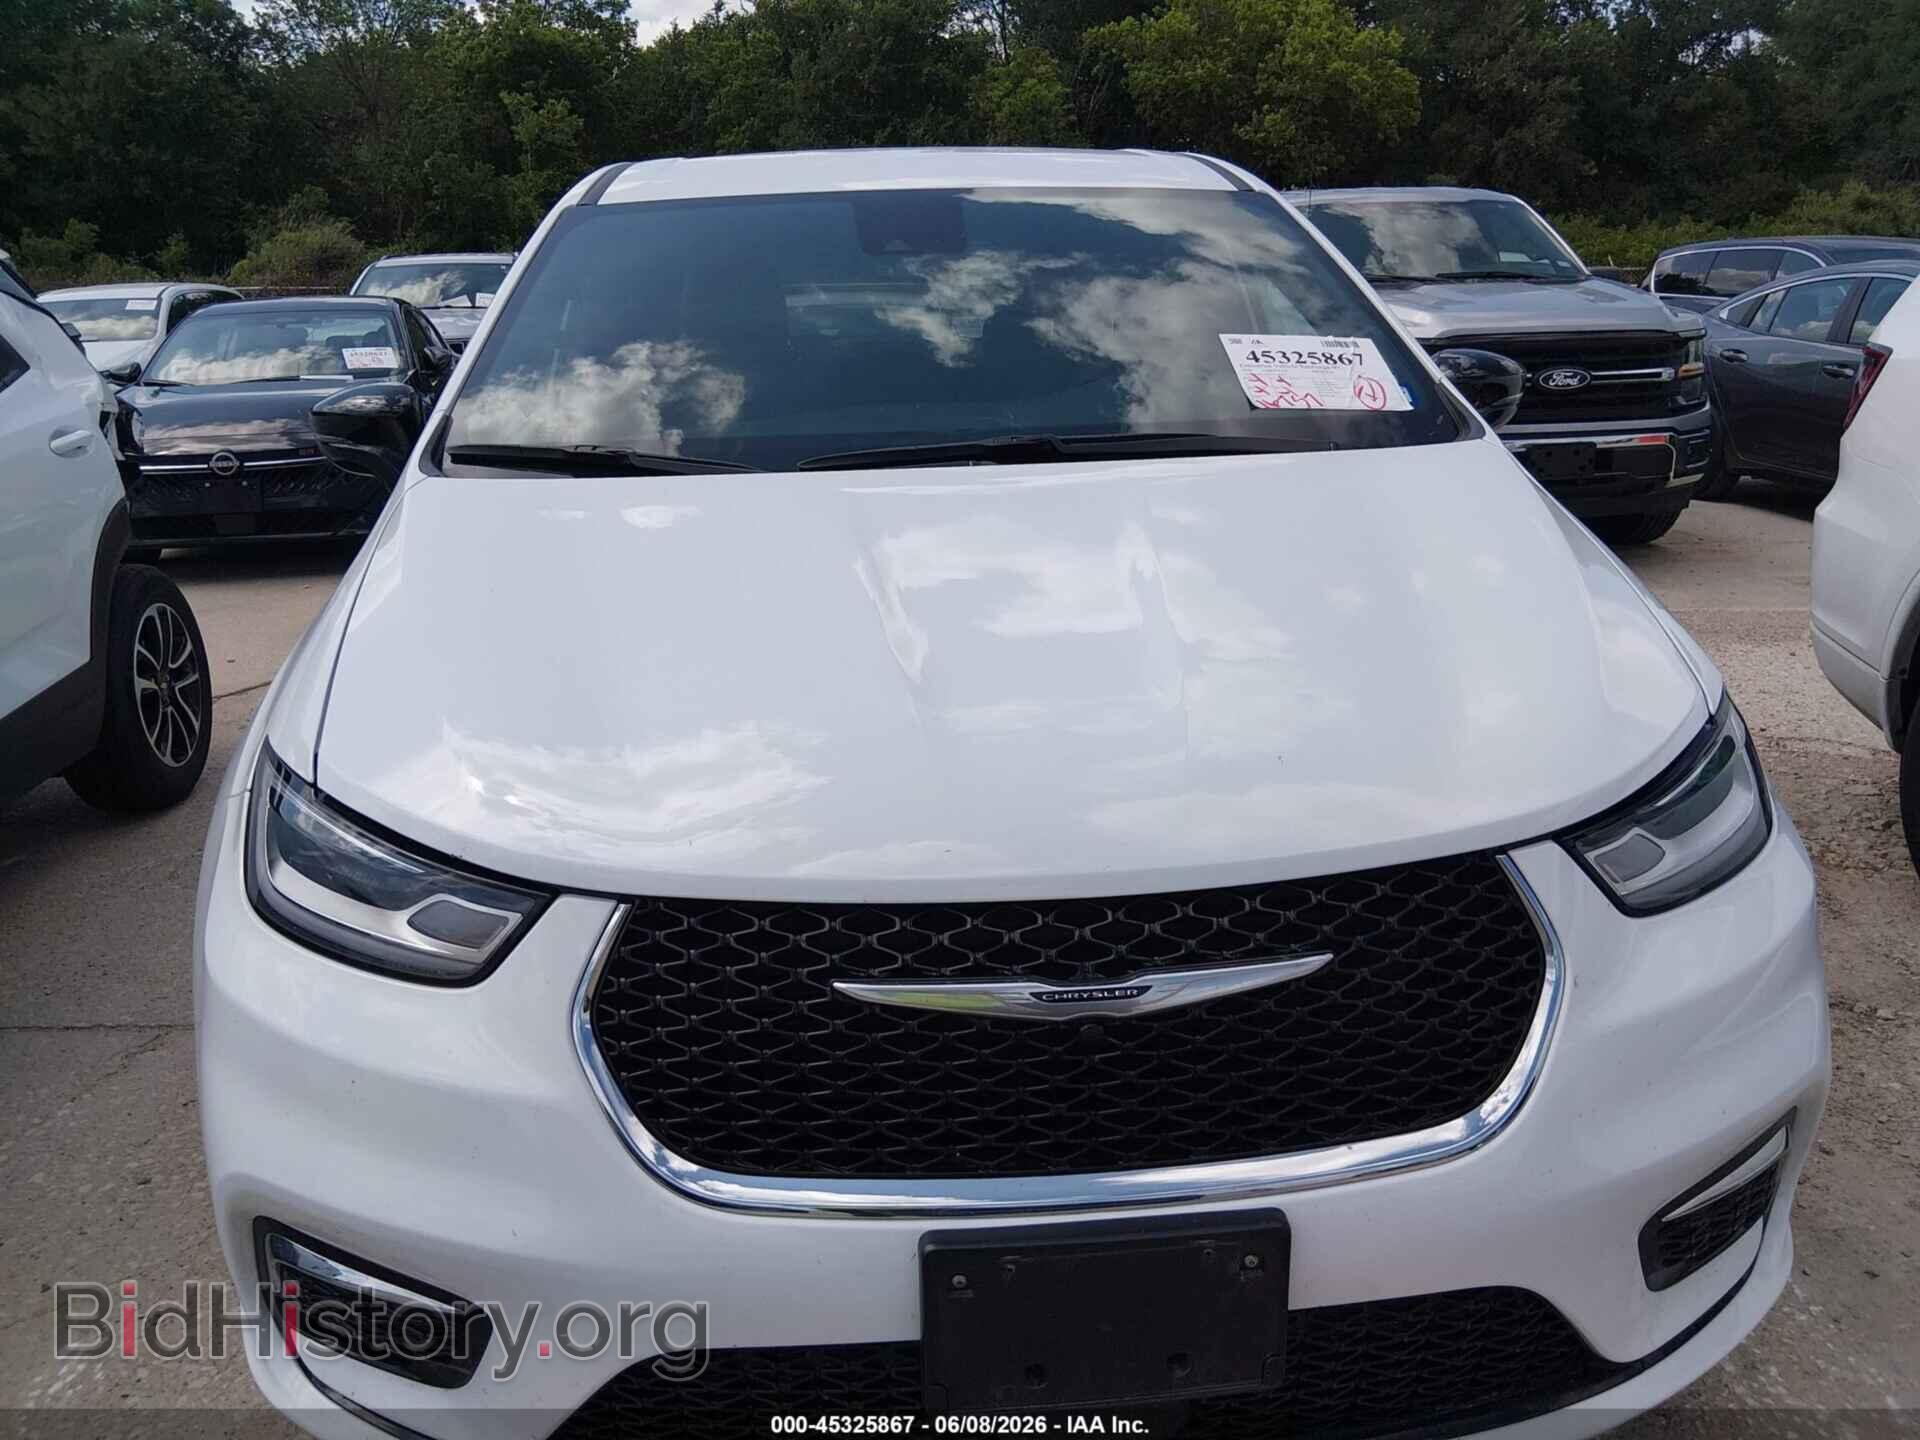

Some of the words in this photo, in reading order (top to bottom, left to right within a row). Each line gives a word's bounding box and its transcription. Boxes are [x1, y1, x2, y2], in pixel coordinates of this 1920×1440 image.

[1246, 350, 1363, 366] 45325867
[1548, 372, 1581, 386] Ford
[1042, 989, 1138, 1000] CHRYSLER
